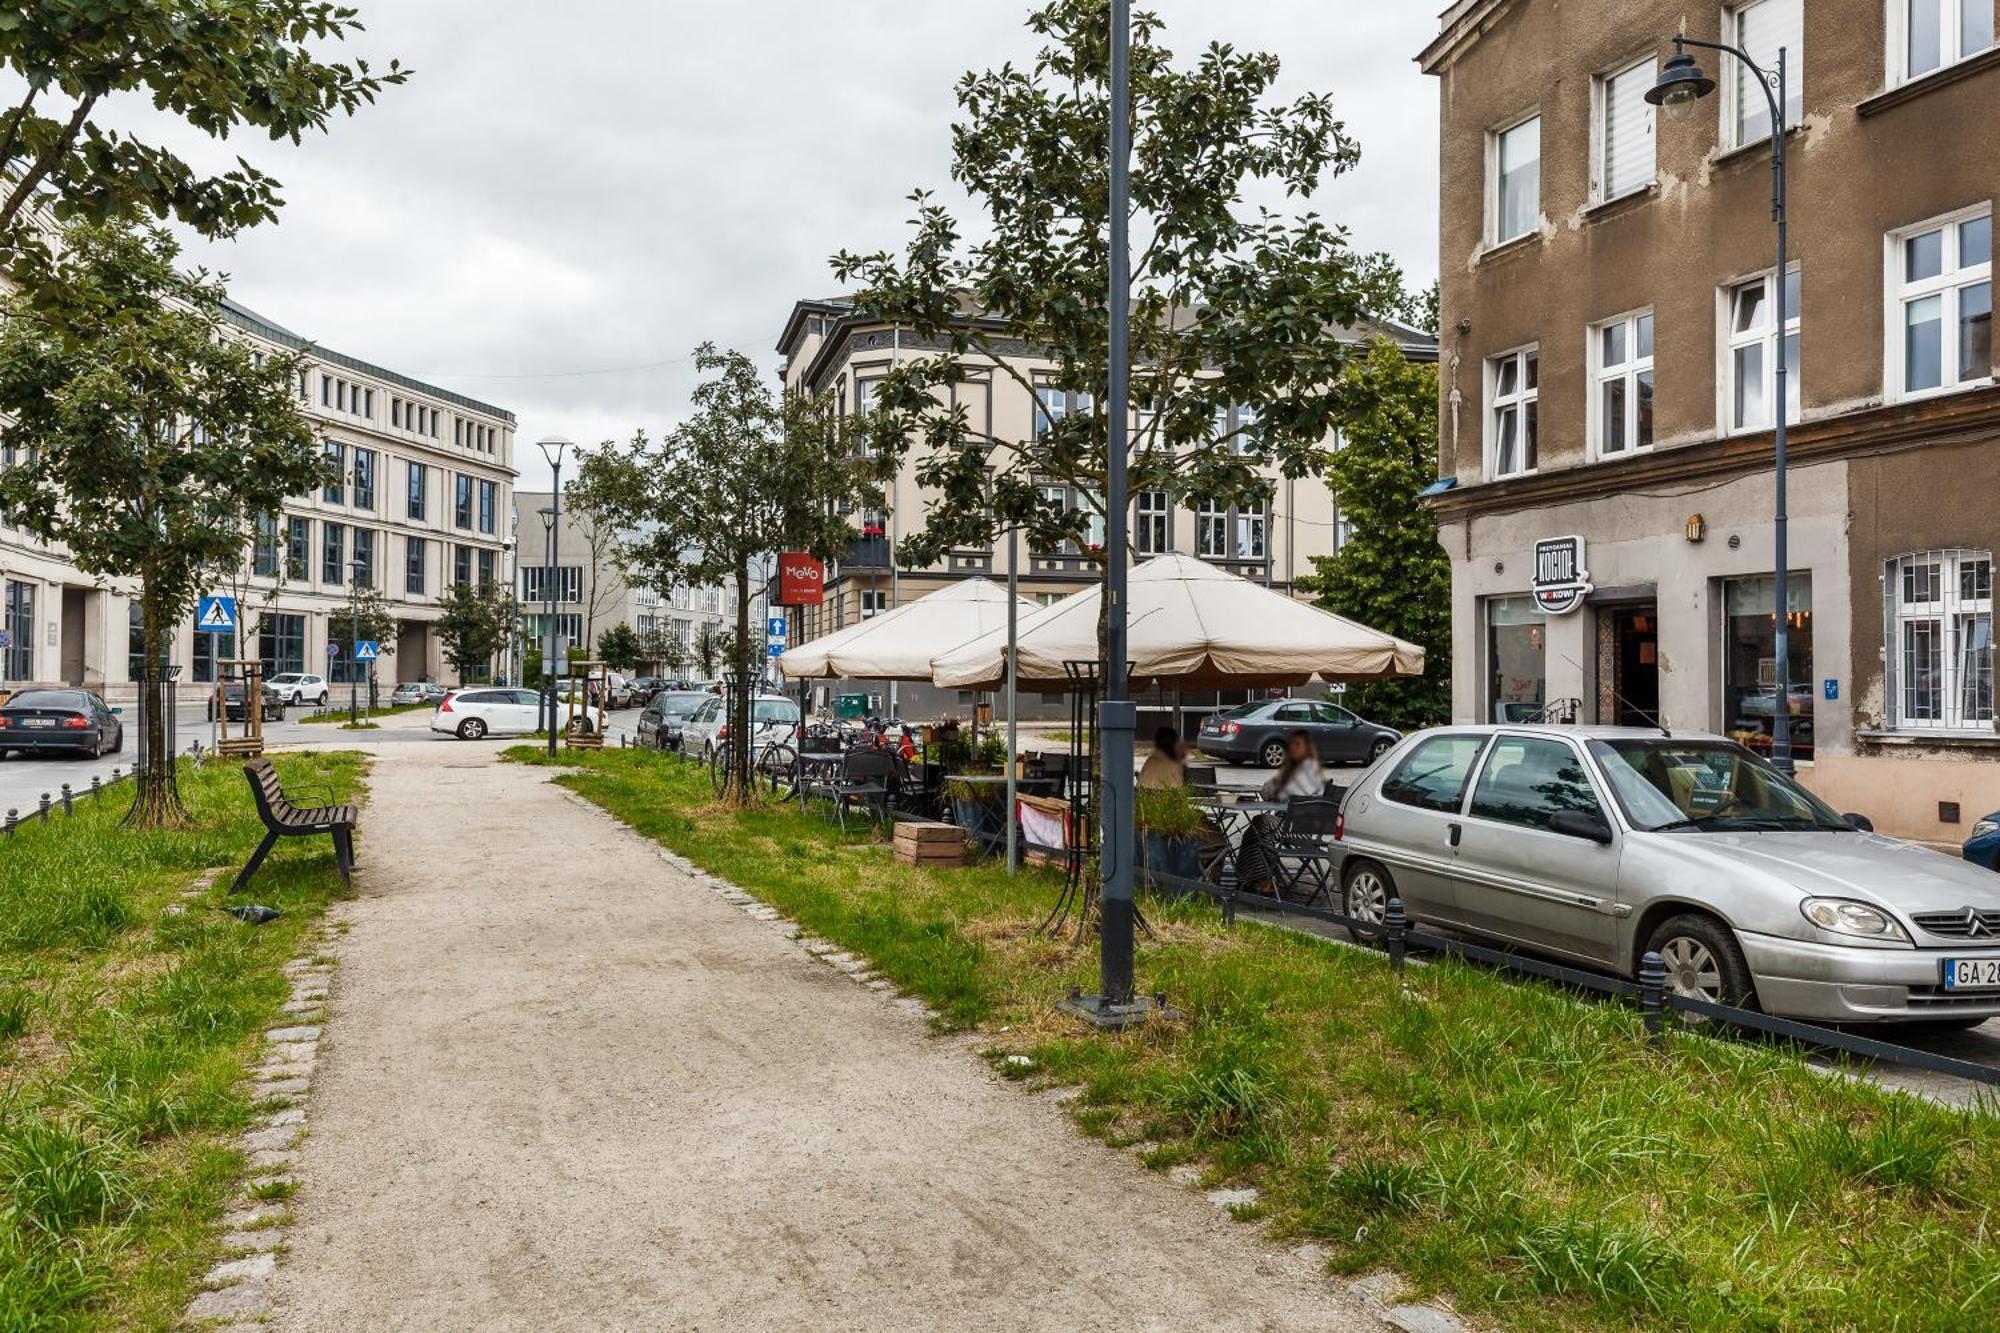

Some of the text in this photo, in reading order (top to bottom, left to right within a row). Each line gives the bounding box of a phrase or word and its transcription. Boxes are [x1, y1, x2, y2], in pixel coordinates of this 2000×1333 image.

[1539, 550, 1574, 582] KOCIOŁ
[1539, 589, 1574, 600] WOKOWI
[1958, 962, 1980, 984] GA
